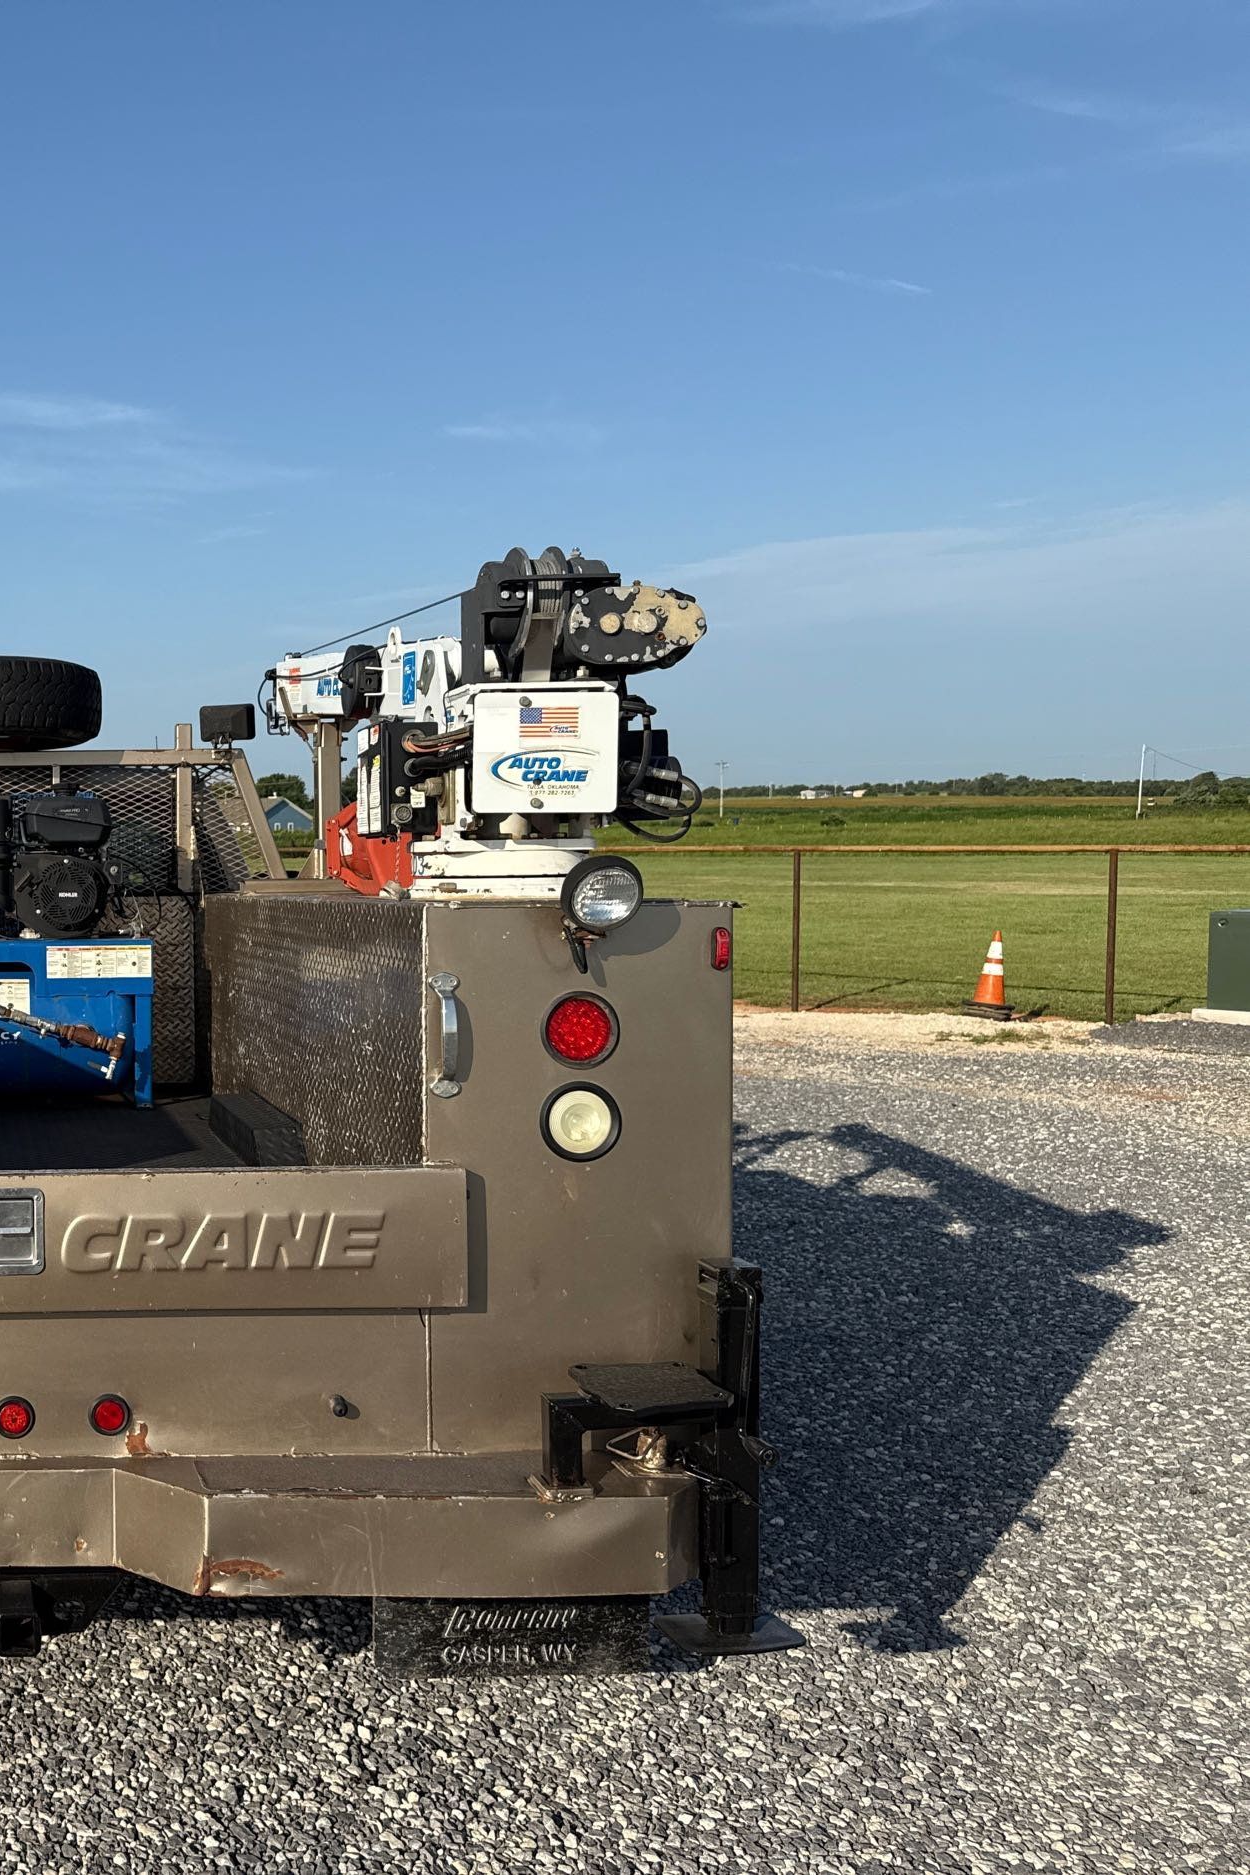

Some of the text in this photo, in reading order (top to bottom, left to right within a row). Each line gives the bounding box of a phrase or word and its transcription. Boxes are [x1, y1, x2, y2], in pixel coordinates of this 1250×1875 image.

[508, 757, 561, 769] AUTO
[521, 770, 589, 782] CRANE
[61, 1212, 386, 1274] CRANE
[541, 1643, 578, 1663] WY
